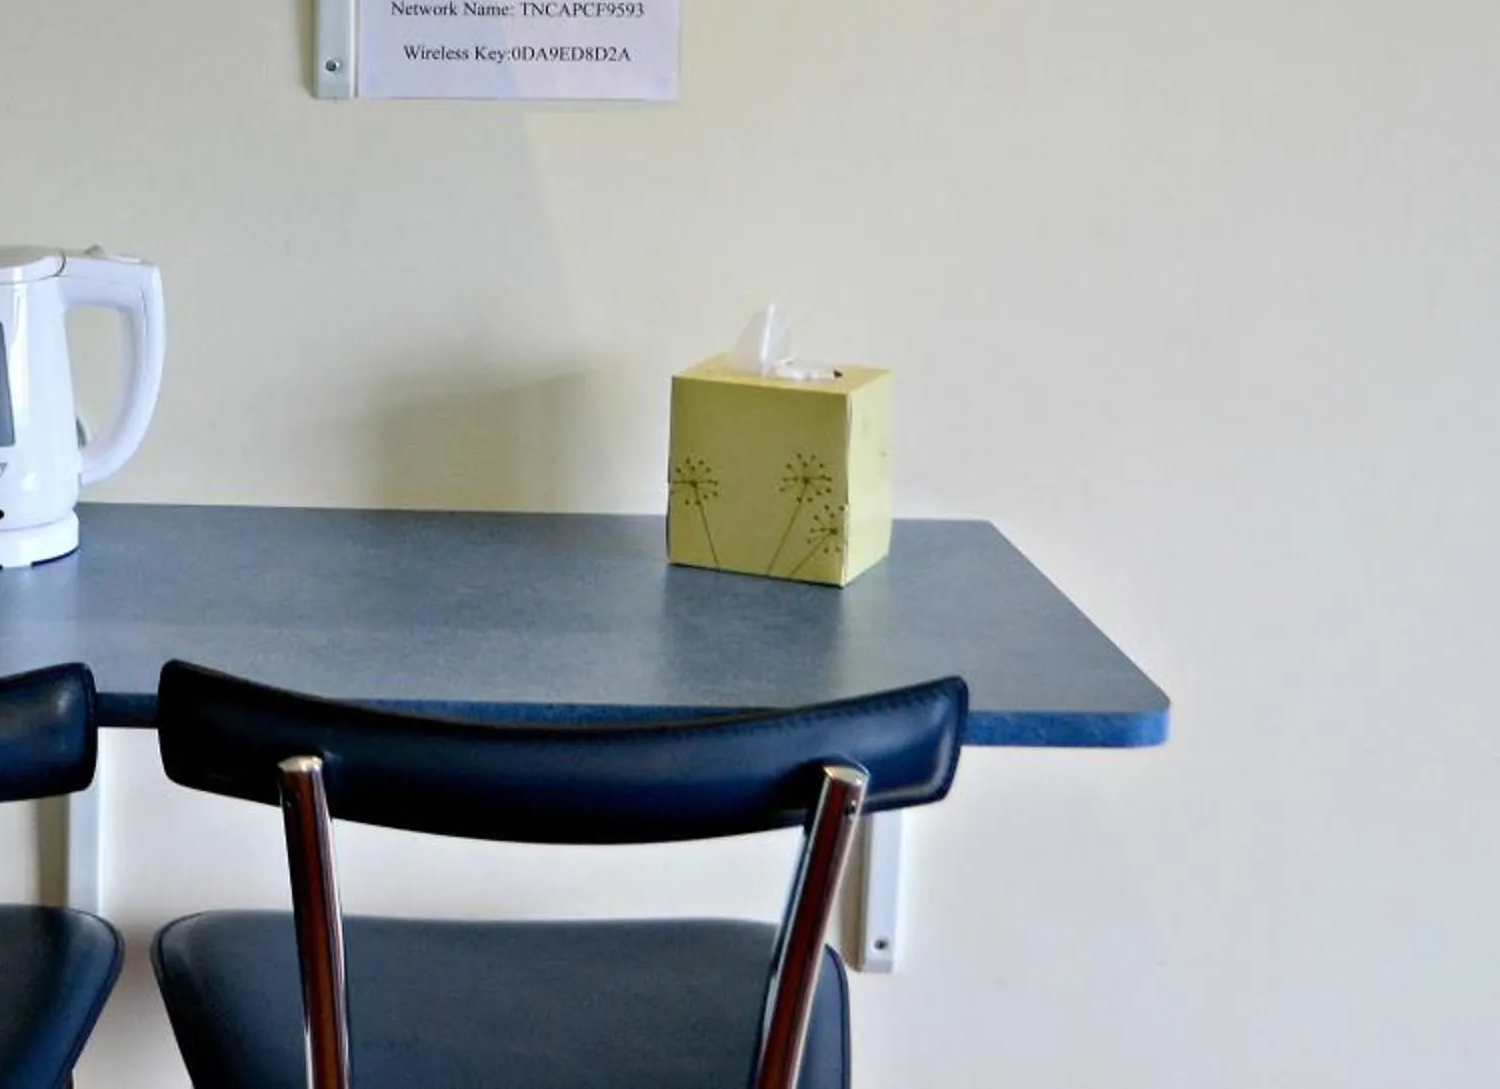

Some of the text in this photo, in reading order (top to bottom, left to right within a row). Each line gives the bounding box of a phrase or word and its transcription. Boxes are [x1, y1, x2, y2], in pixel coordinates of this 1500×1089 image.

[390, 0, 645, 18] Network Name: TNCAPCF9593
[404, 45, 469, 61] Wireless
